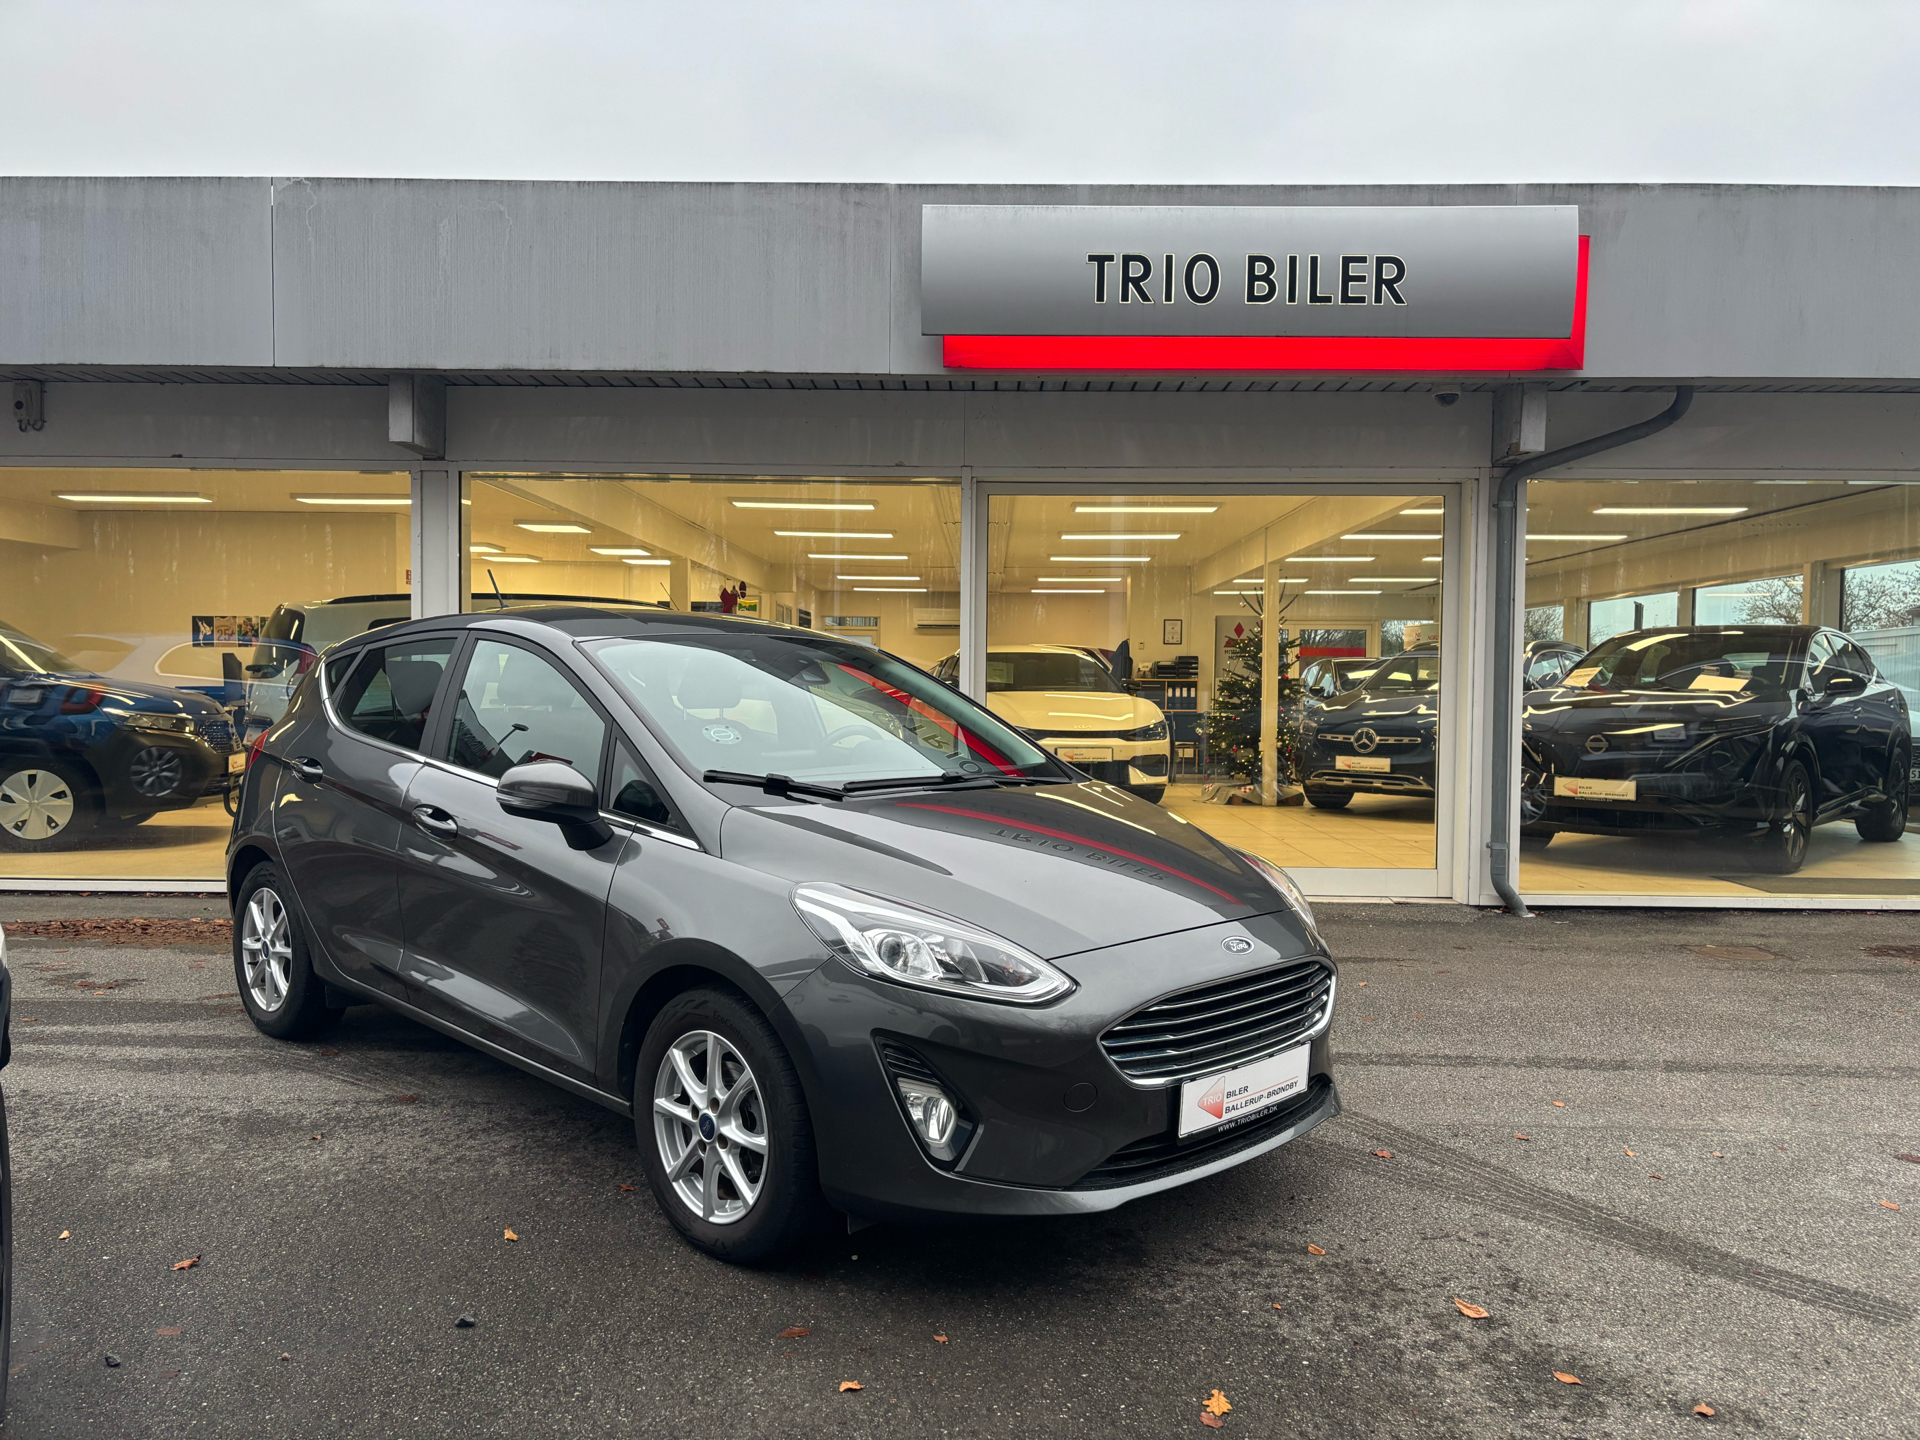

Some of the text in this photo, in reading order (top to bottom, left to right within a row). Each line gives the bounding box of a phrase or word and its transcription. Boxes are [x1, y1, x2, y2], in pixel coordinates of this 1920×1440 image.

[1086, 252, 1407, 305] TRIO BILER
[1203, 1093, 1222, 1106] TRIO
[1225, 1080, 1298, 1114] BALLERUP BRØNDBY
[1226, 1085, 1249, 1099] BILER
[1217, 1105, 1278, 1132] WWW.TRIOBILER.DK
